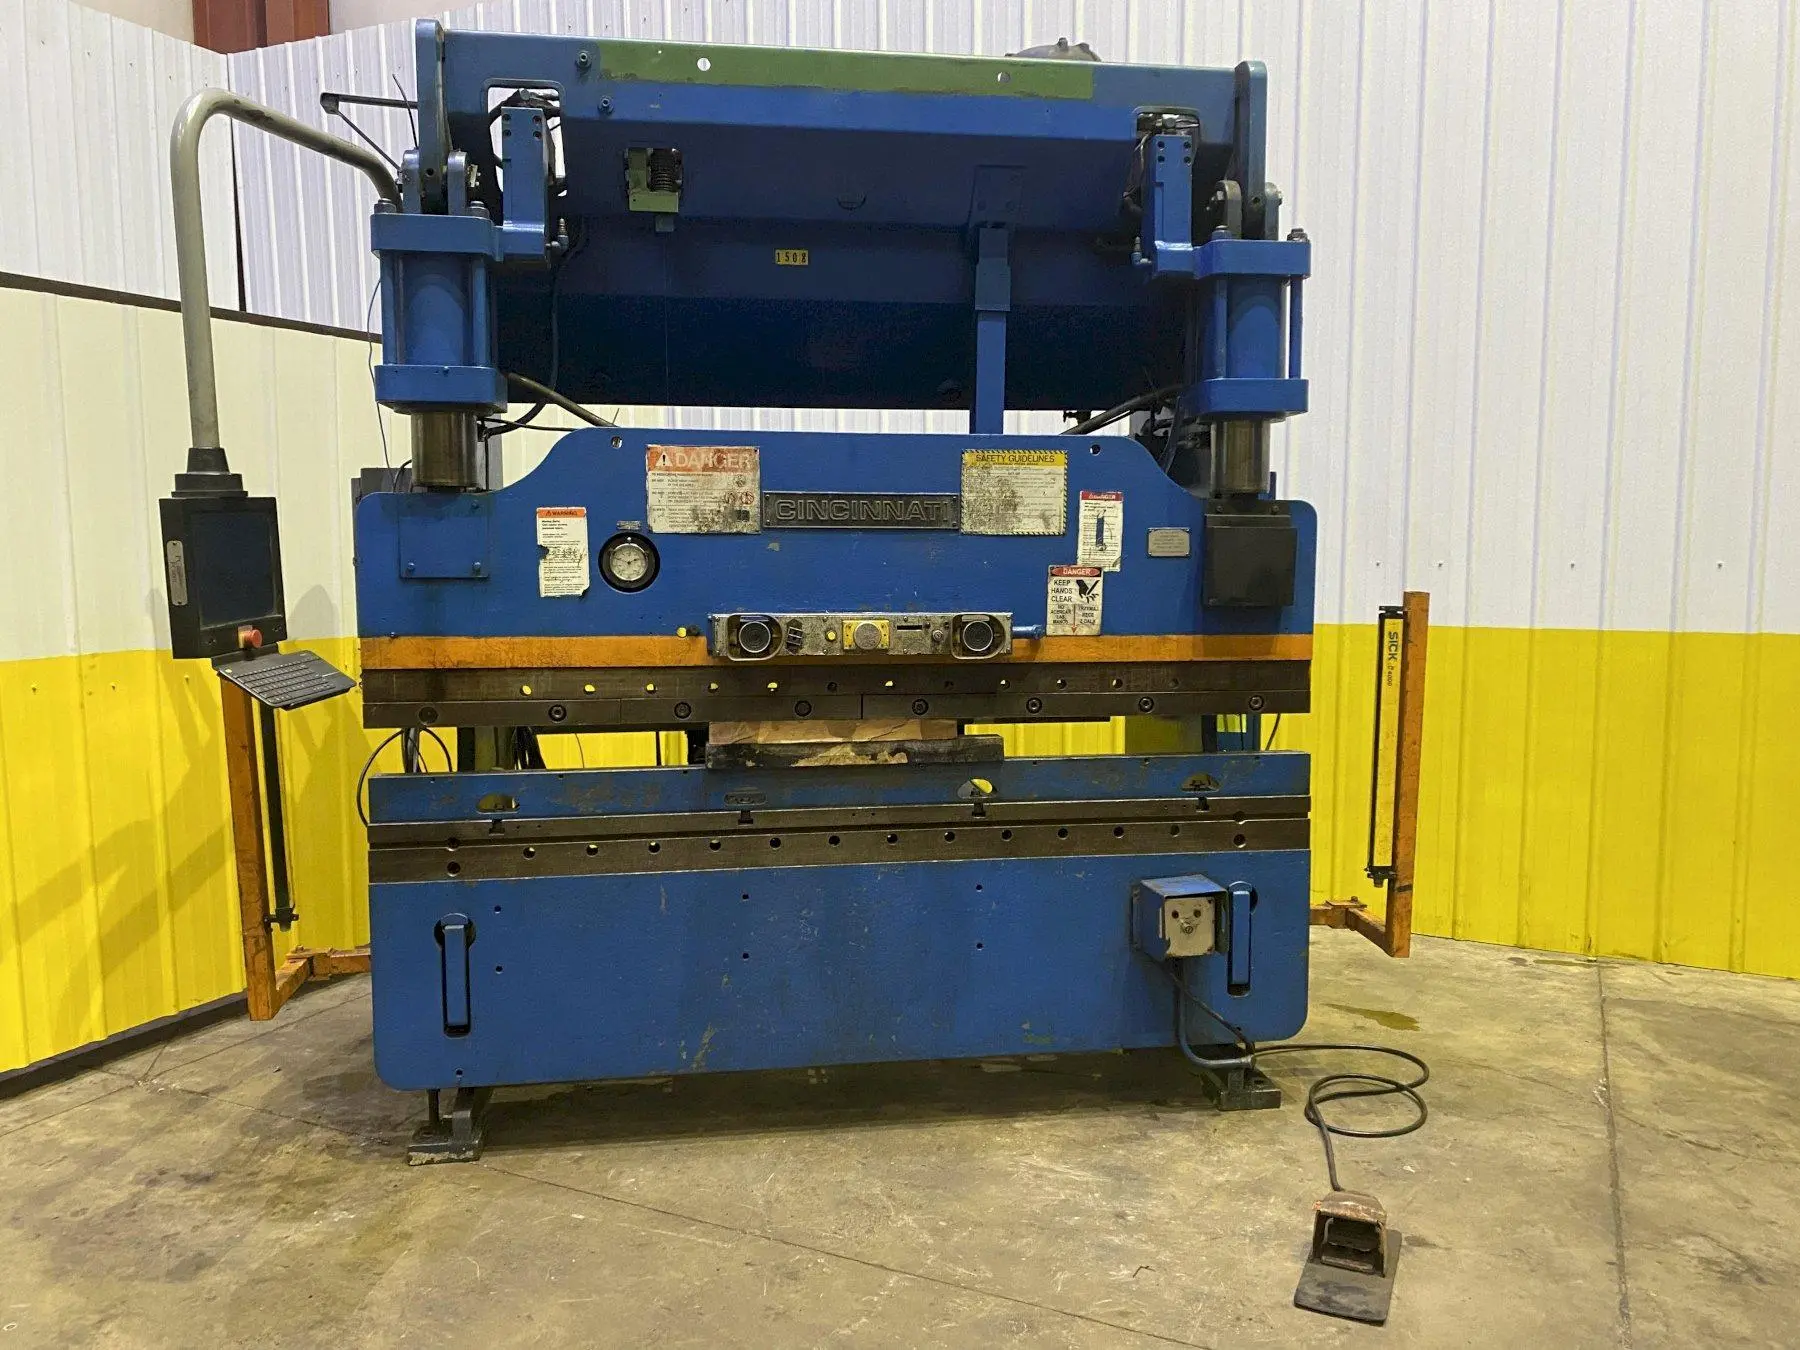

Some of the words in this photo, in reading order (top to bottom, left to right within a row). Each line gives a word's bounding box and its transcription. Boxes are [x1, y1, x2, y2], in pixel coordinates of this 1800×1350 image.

[776, 251, 807, 263] 1508
[675, 453, 750, 468] DANGER
[975, 454, 1007, 462] SAFETY
[1008, 454, 1055, 463] GUIDELINES
[775, 499, 949, 521] CINCINNATI
[1062, 567, 1091, 576] DANGER
[1050, 595, 1073, 603] CLEAR
[1387, 631, 1399, 661] SICK
